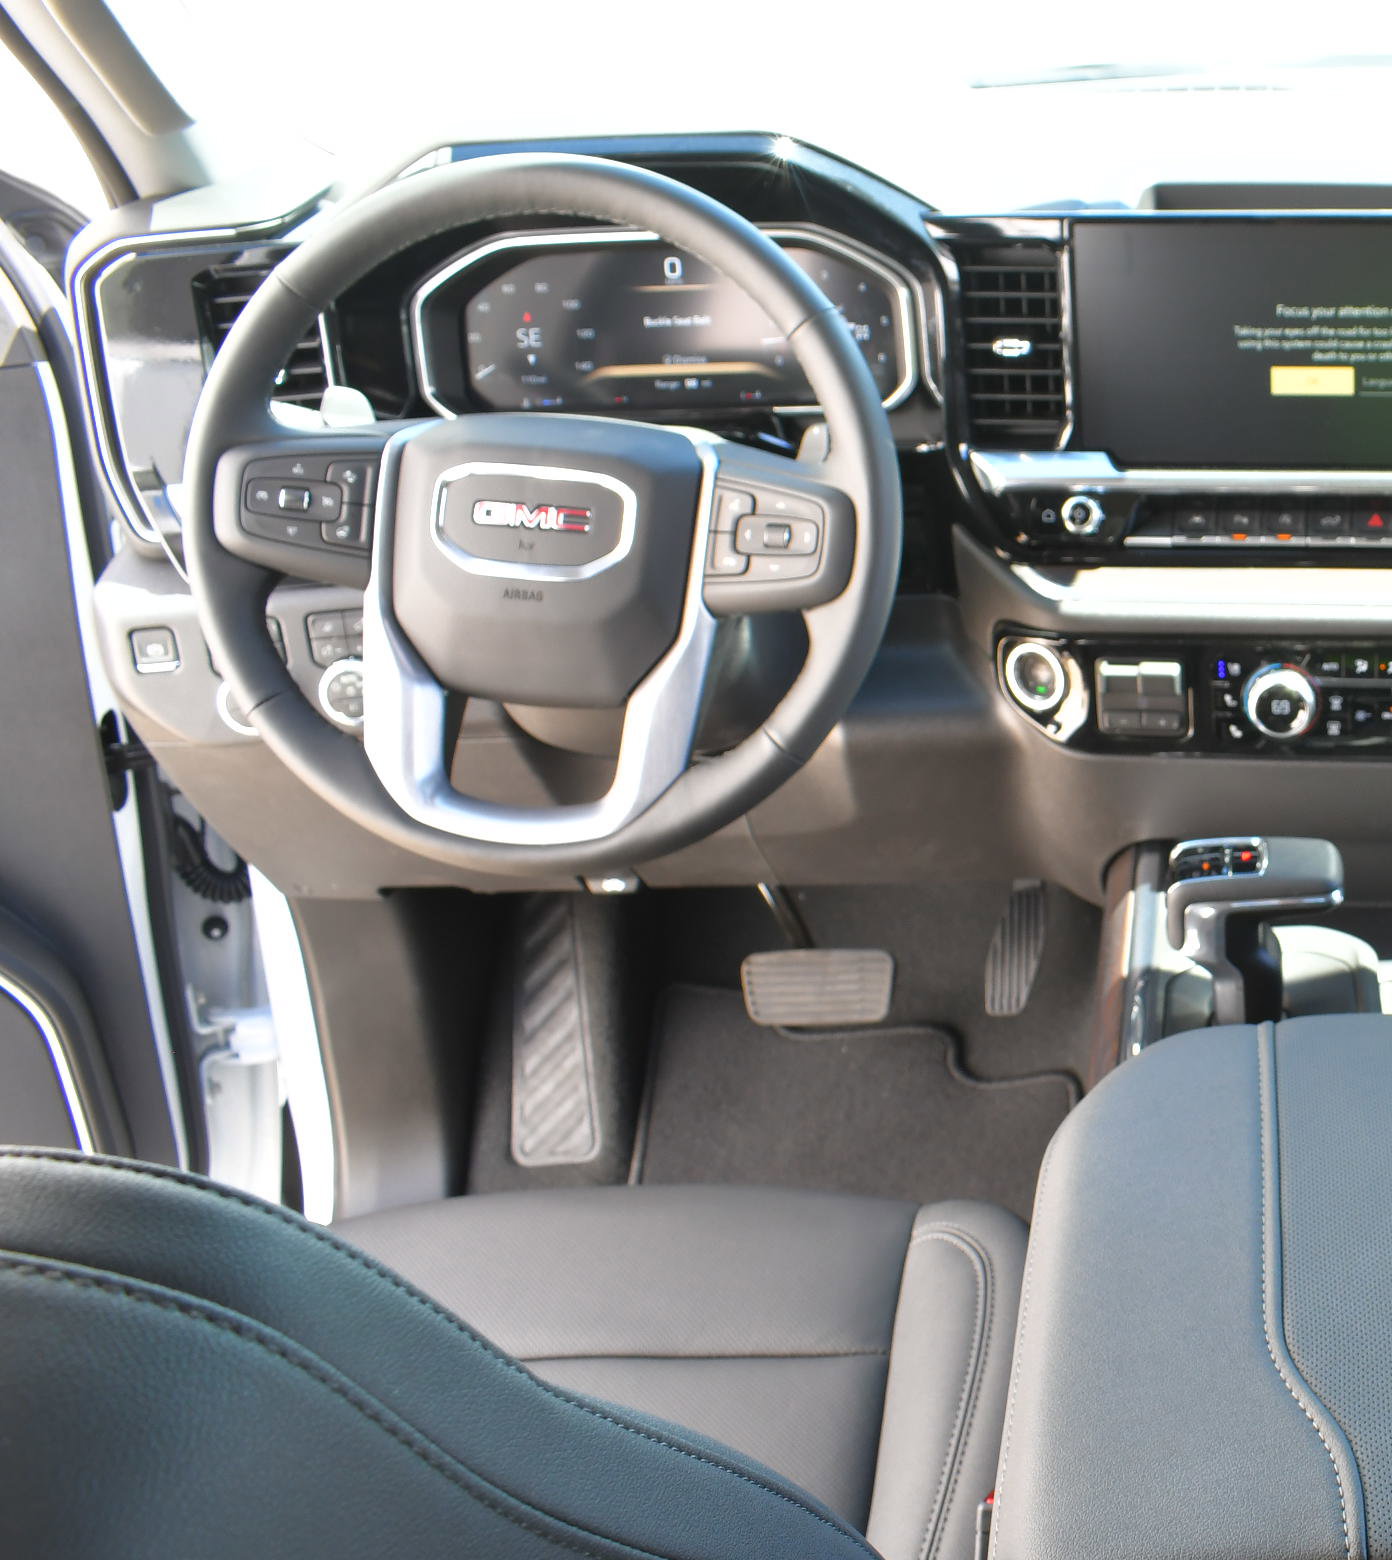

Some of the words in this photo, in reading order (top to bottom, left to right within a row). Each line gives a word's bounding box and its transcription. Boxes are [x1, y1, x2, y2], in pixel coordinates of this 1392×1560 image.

[1276, 304, 1311, 318] Focus
[1312, 306, 1336, 321] your
[1337, 305, 1390, 319] attention
[516, 327, 542, 348] SE
[1233, 325, 1264, 339] Taking
[1264, 327, 1283, 339] your
[1284, 327, 1305, 339] eyes
[1306, 325, 1320, 338] off
[1321, 325, 1336, 338] the
[1337, 326, 1357, 338] road
[1358, 325, 1372, 338] for
[1373, 326, 1389, 338] too
[1237, 339, 1262, 352] using
[1263, 338, 1280, 350] this
[1281, 339, 1312, 352] system
[1313, 338, 1339, 350] could
[1340, 340, 1365, 350] cause
[1311, 351, 1337, 362] death
[1350, 352, 1366, 364] you
[472, 499, 591, 532] GMC
[502, 587, 543, 601] AIRBAG
